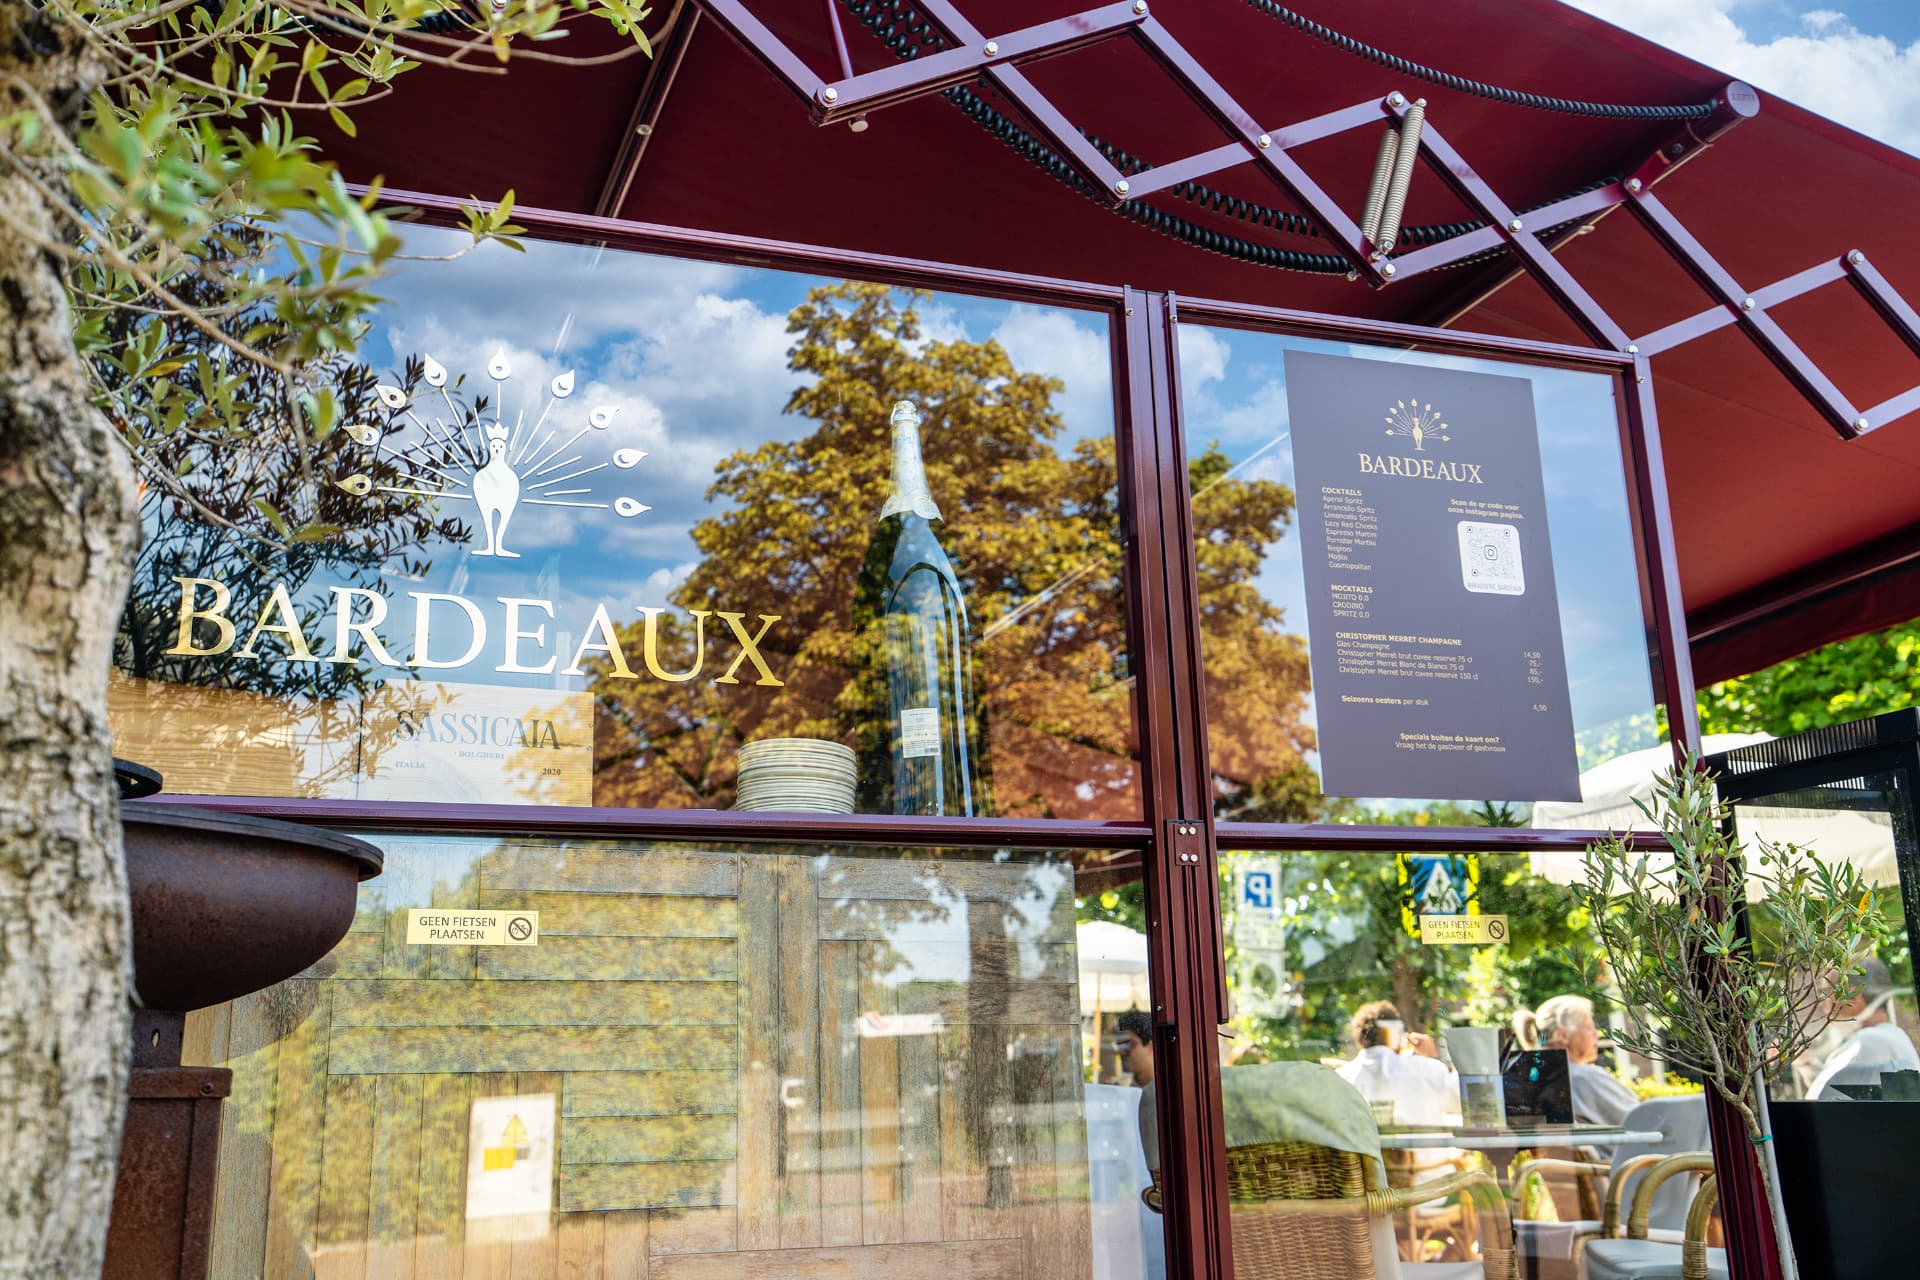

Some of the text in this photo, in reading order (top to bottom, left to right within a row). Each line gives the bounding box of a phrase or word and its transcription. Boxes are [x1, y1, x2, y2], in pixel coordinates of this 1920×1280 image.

[1358, 453, 1484, 484] BARDEAUX
[1322, 486, 1362, 496] COCKTAILS
[1322, 495, 1343, 504] Aperol
[1450, 498, 1467, 506] Scan
[1356, 506, 1376, 514] Spritz
[1324, 512, 1377, 523] Limoncello Spritz
[1325, 520, 1340, 528] Lazy
[1355, 522, 1378, 530] Cheeks
[1326, 528, 1377, 538] Espresso Martini
[1354, 538, 1377, 546] Martini
[1328, 544, 1352, 554] Negroni
[1328, 552, 1348, 562] Mojito
[1328, 561, 1372, 571] Cosmopolitan
[1331, 584, 1374, 594] MOCKTAILS
[1332, 593, 1369, 602] MOJITO 0.0
[1332, 601, 1364, 610] CRODINO
[1333, 610, 1370, 619] SPRITZ 0.0
[166, 576, 785, 688] BARDEAUX
[1336, 632, 1462, 646] CHRISTOPHER MERRET CHAMPAGNE
[1352, 641, 1390, 650] Champagne
[1337, 648, 1374, 658] Christopher
[1376, 651, 1397, 659] Merret
[1398, 652, 1412, 660] brut
[1457, 656, 1466, 664] 75
[1338, 657, 1376, 667] Christopher
[1376, 659, 1398, 668] Merret
[1399, 660, 1416, 669] Blanc
[1428, 662, 1448, 670] Blancs
[1339, 666, 1376, 676] Christopher
[1378, 668, 1399, 676] Merret
[1400, 669, 1414, 677] brut
[1460, 672, 1472, 680] 150
[1342, 695, 1430, 706] Seizoens oesters per stuk
[396, 710, 561, 750] SASSICAIA
[1400, 732, 1430, 742] Specials
[1430, 734, 1454, 742] buiten
[1395, 741, 1414, 750] Vraag
[1416, 742, 1426, 750] het
[1474, 744, 1506, 753] gastvrouw
[458, 752, 504, 760] BOLGHERI
[395, 761, 425, 769] ITALIA
[542, 768, 562, 776] 2020
[420, 916, 496, 927] GEEN FIETSEN
[1428, 920, 1480, 929] GEEN FIETSEN
[430, 929, 484, 940] PLAATSEN
[1436, 931, 1474, 940] PLAATSEN
